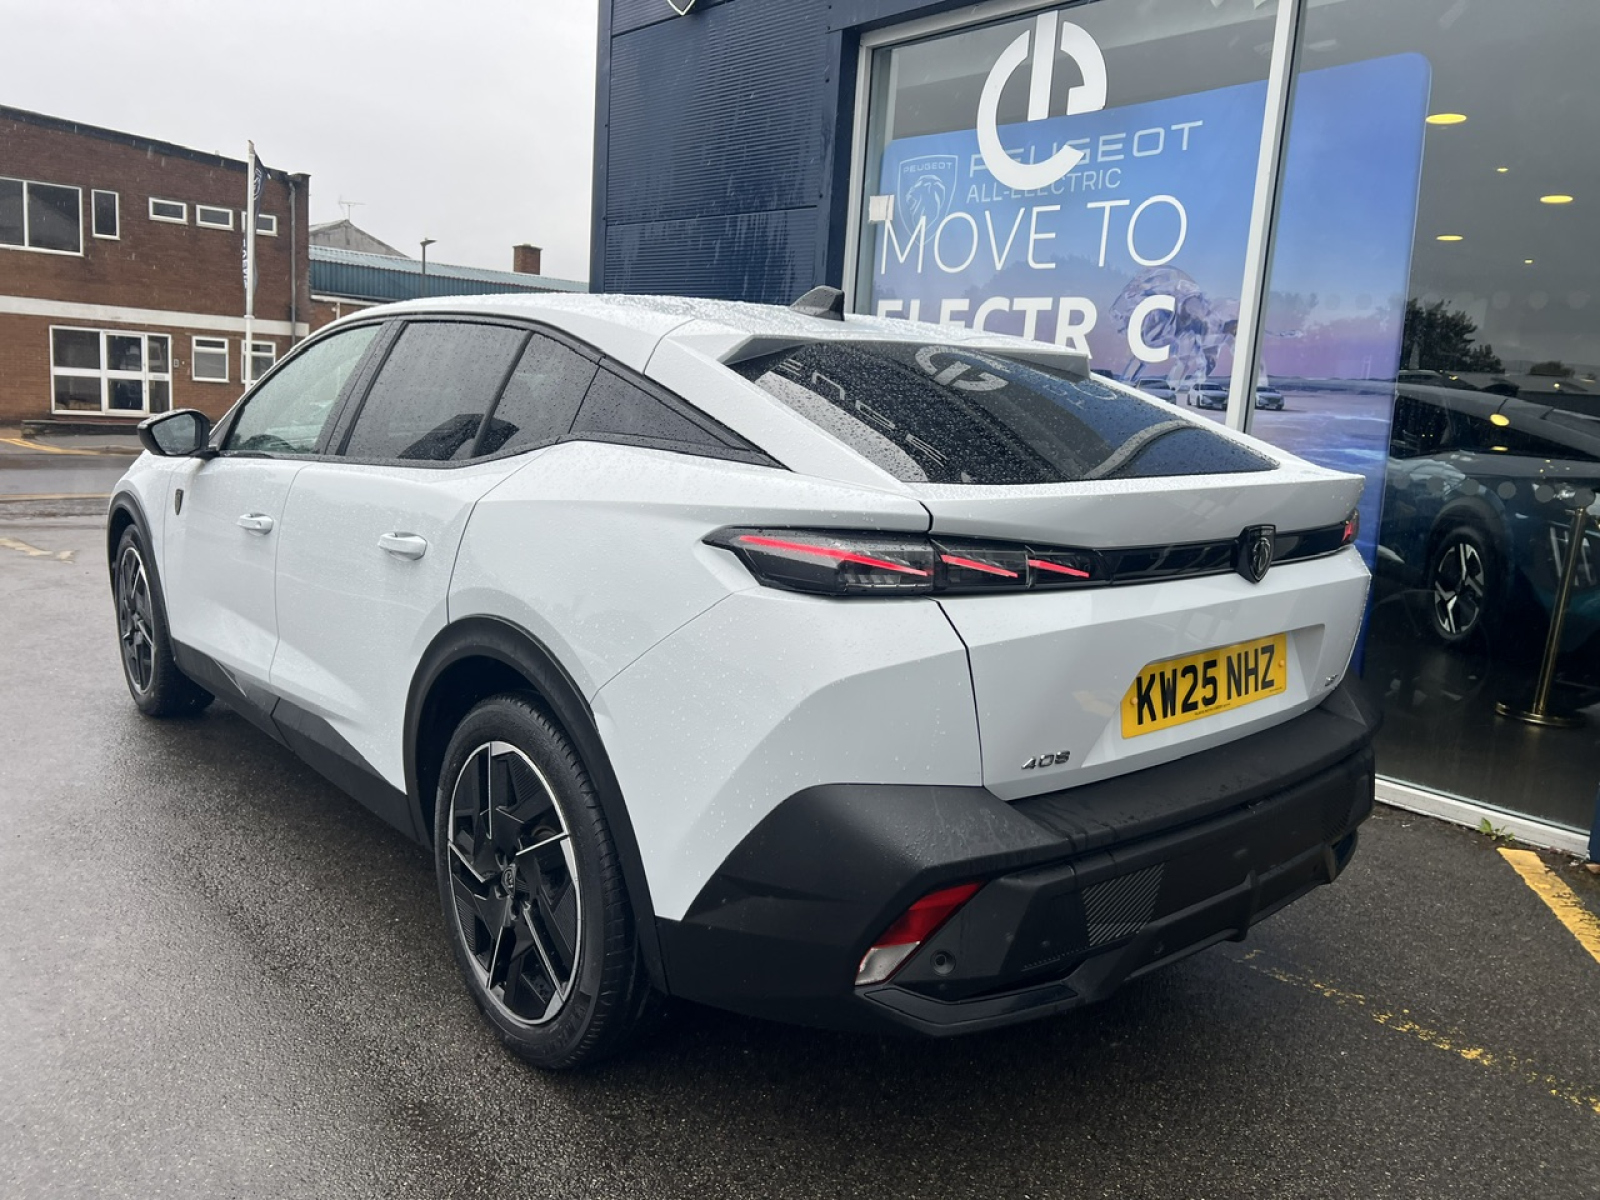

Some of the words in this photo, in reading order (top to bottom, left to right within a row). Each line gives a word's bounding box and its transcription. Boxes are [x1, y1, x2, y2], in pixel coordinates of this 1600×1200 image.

[880, 204, 1061, 275] MOVE
[1086, 194, 1187, 268] TO
[1136, 659, 1218, 726] KW25
[1227, 643, 1276, 701] NHZ
